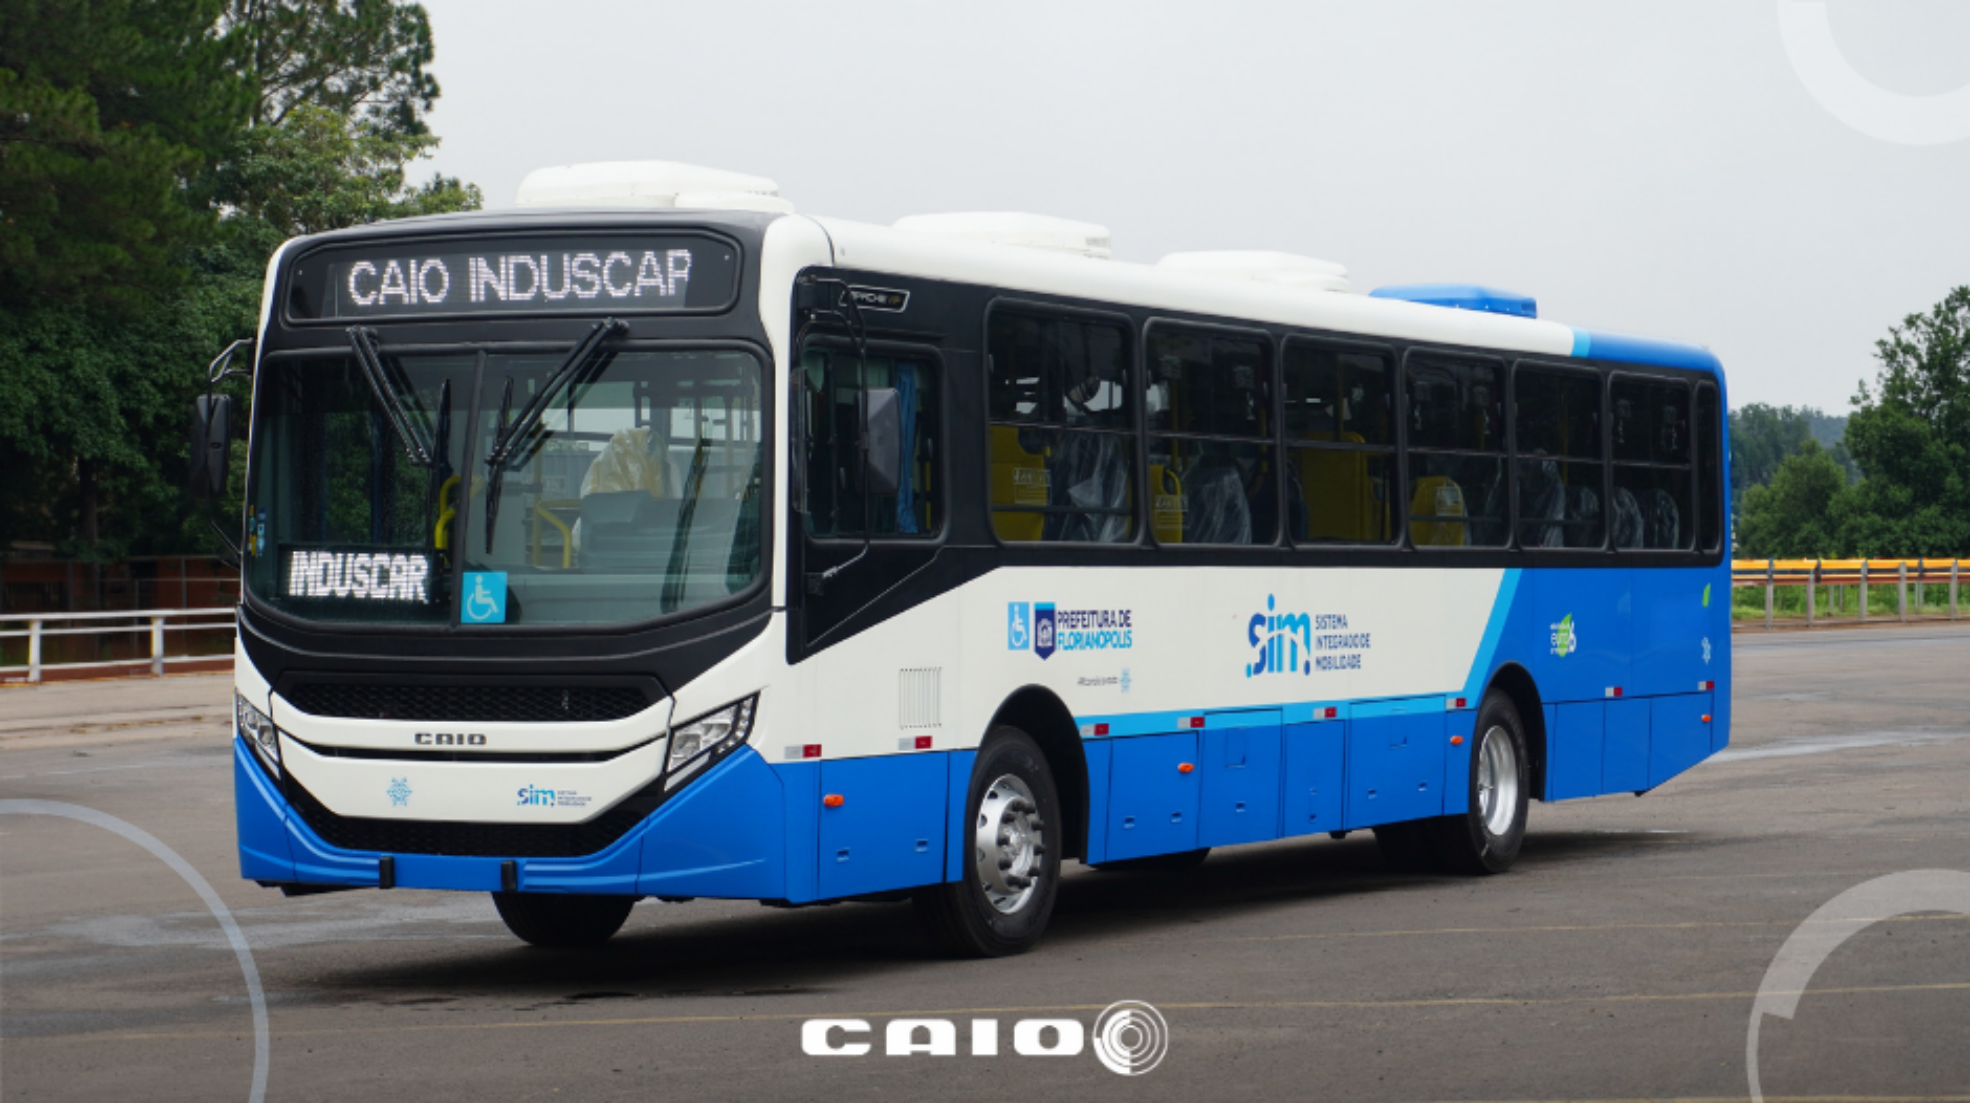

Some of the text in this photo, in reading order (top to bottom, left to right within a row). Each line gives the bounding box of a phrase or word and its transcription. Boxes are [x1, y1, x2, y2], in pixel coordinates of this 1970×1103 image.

[347, 258, 450, 305] CAIO
[288, 551, 430, 604] INDUSCAR
[1057, 609, 1132, 629] PREFEITURA DE
[1315, 614, 1348, 630] SISTEMA
[1315, 653, 1362, 672] MOBILIDADE
[414, 733, 487, 746] CAIO
